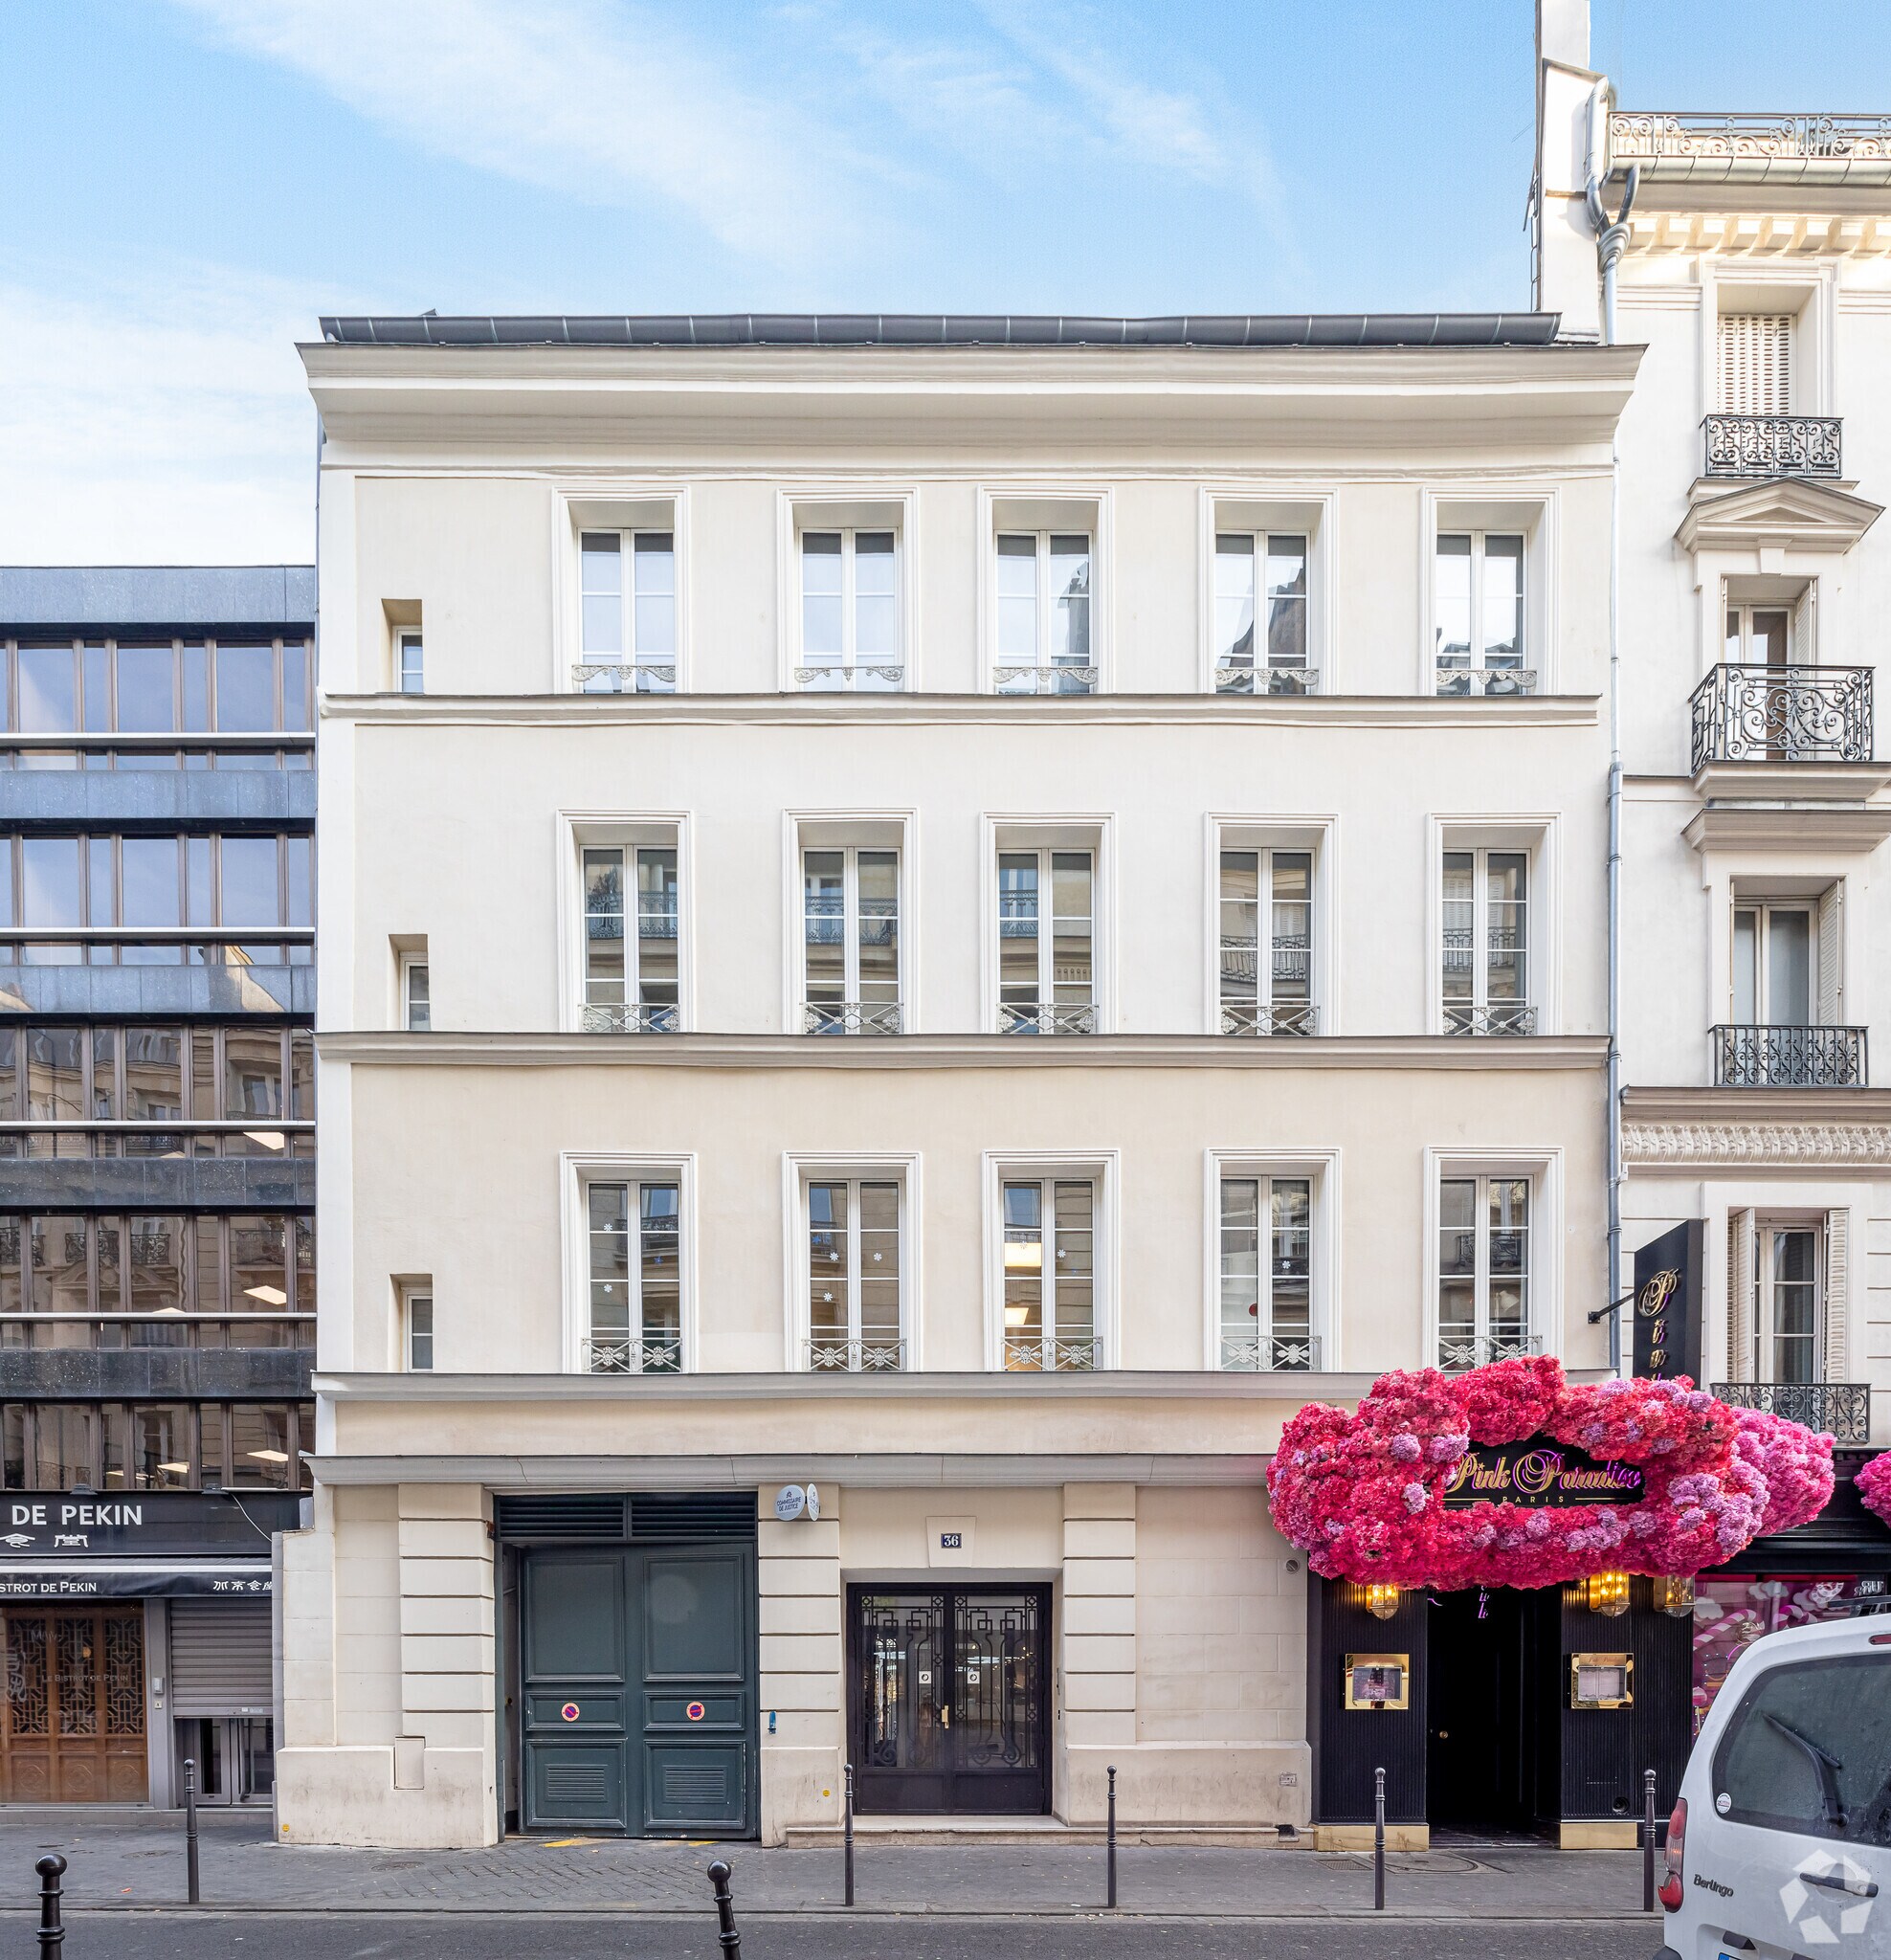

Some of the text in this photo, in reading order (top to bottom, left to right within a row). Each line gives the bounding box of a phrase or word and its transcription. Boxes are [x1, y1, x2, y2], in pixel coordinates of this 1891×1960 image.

[1445, 1449, 1641, 1494] Pink Paradise
[776, 1496, 802, 1506] COMMISSAIRE
[1502, 1495, 1564, 1503] PARIS
[11, 1504, 143, 1526] DE PEKIN
[944, 1534, 959, 1547] 36
[40, 1583, 57, 1592] DE
[59, 1581, 97, 1592] PEKIN
[1693, 1873, 1734, 1898] Berlingo
